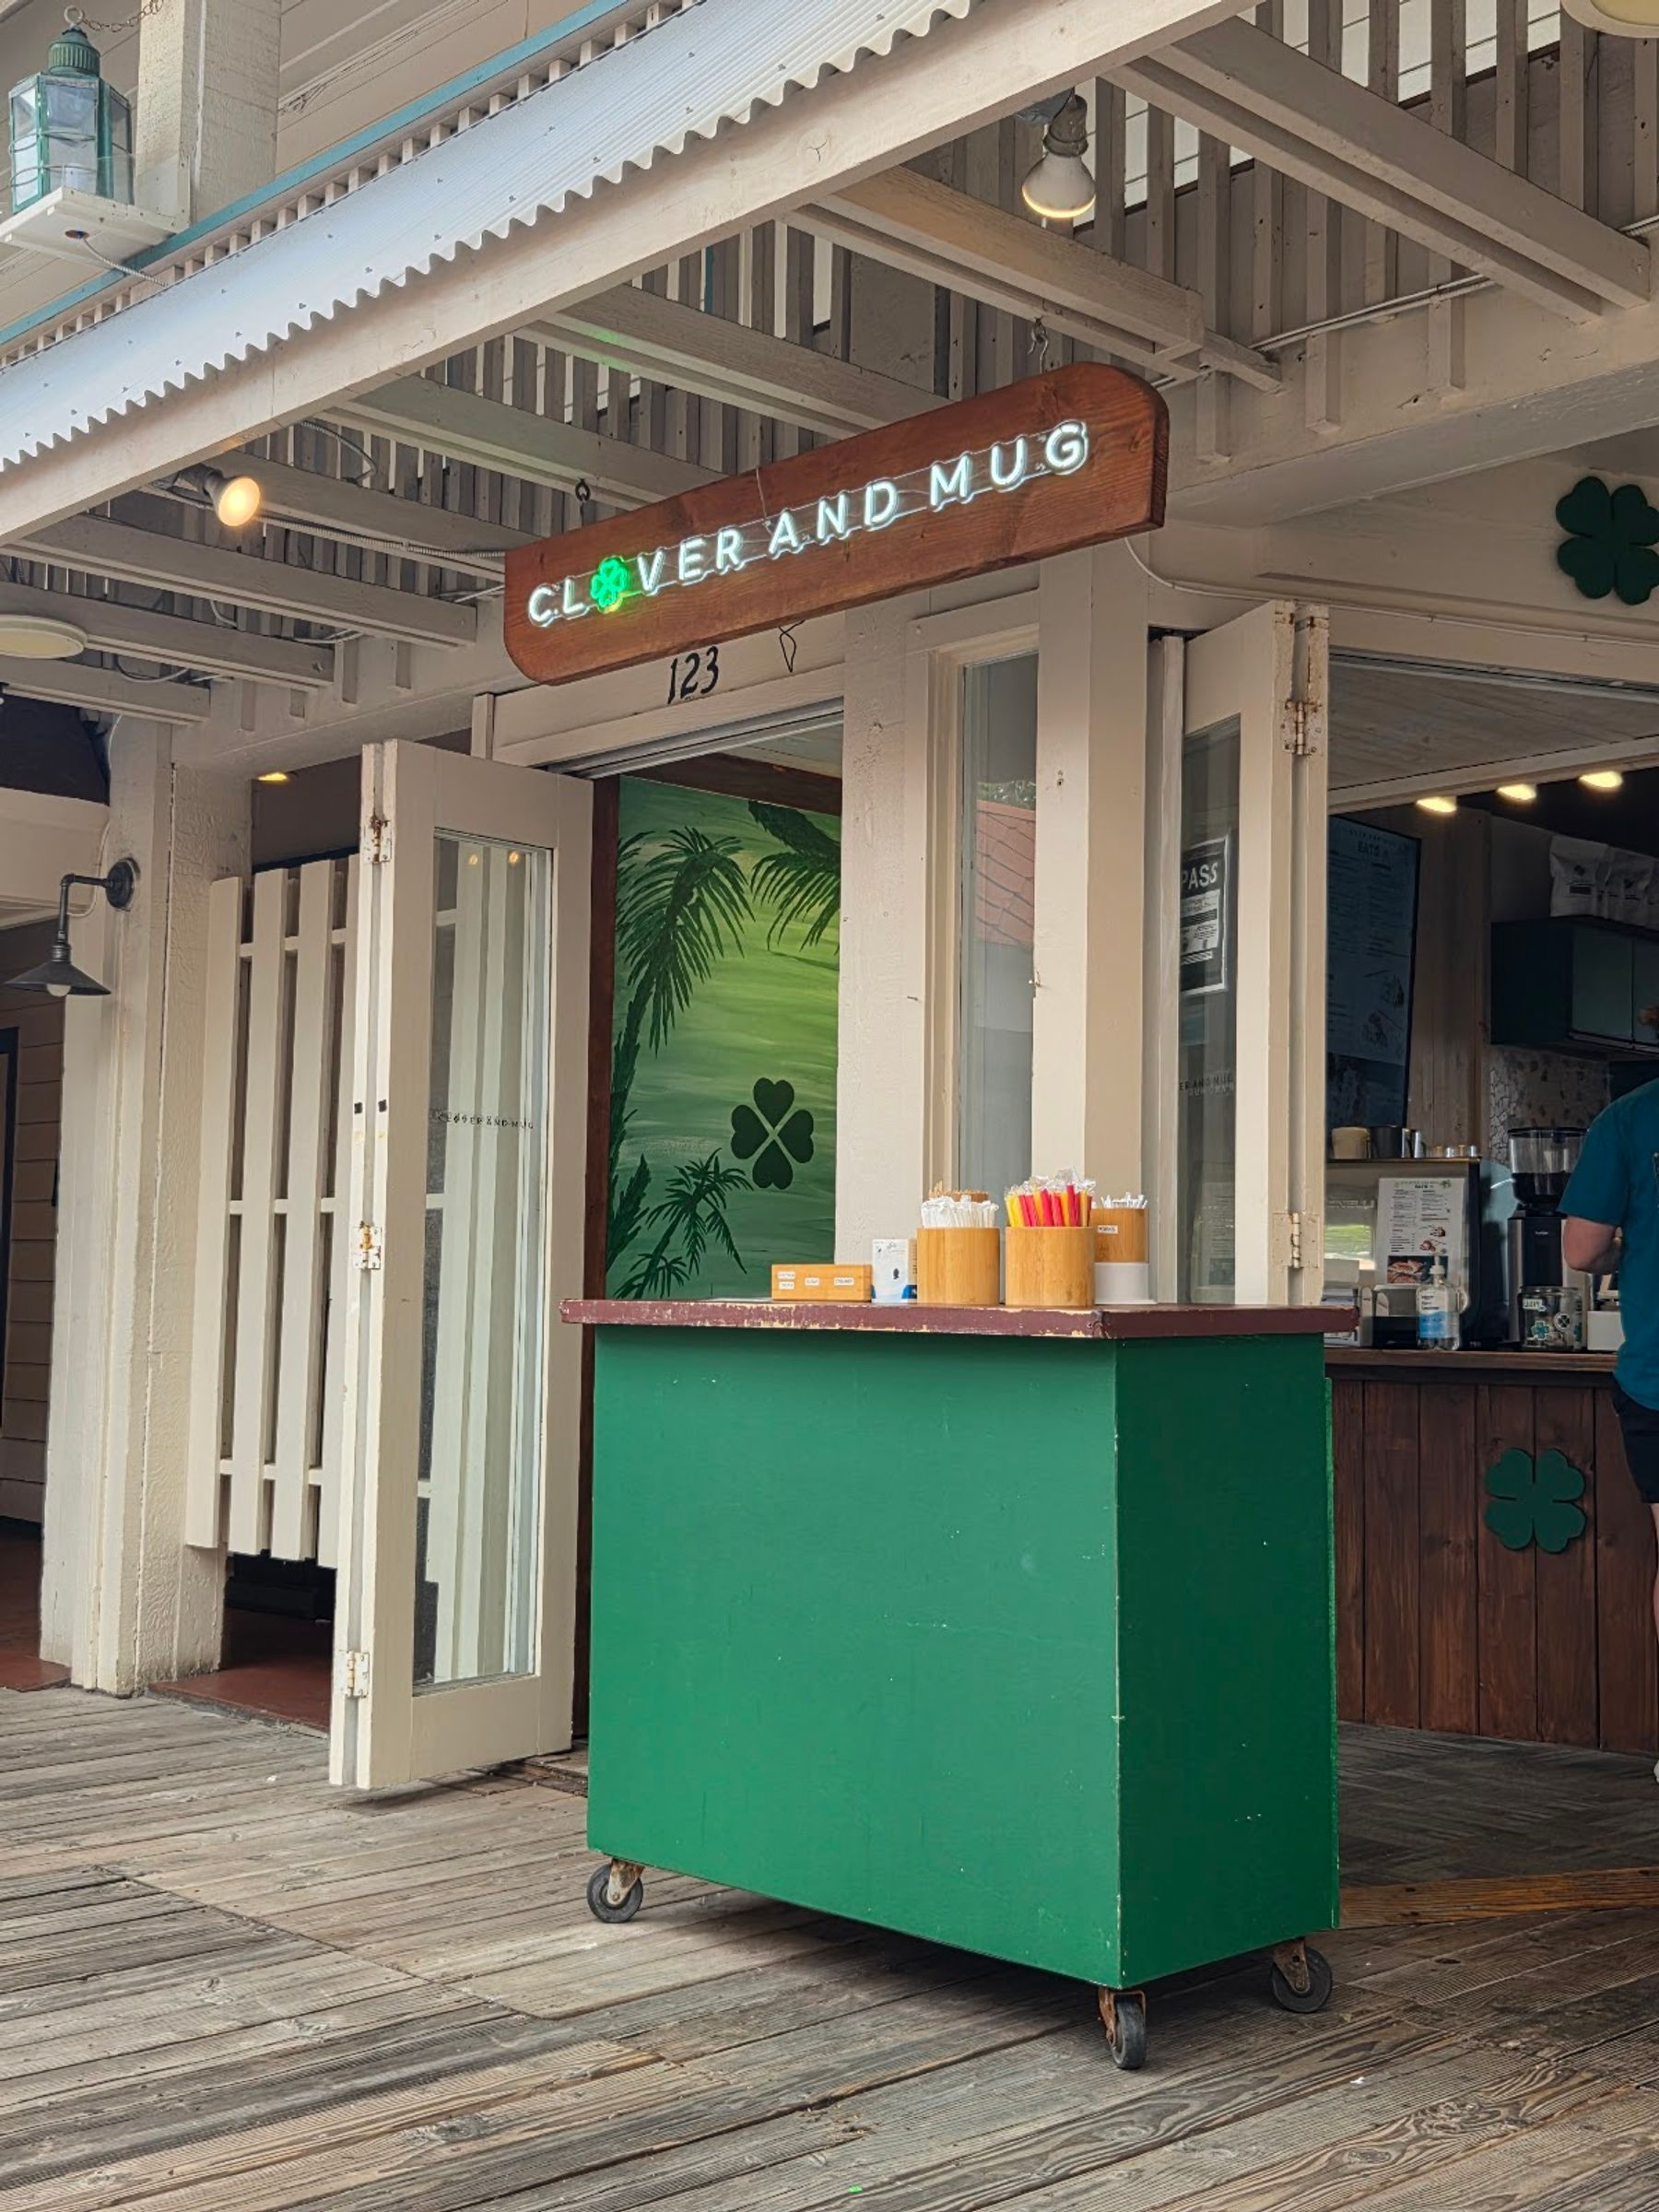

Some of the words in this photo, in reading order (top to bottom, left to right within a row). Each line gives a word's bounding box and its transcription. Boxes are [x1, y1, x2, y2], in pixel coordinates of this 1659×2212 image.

[768, 477, 900, 556] AND
[929, 419, 1088, 512] MUG
[667, 646, 720, 704] 123
